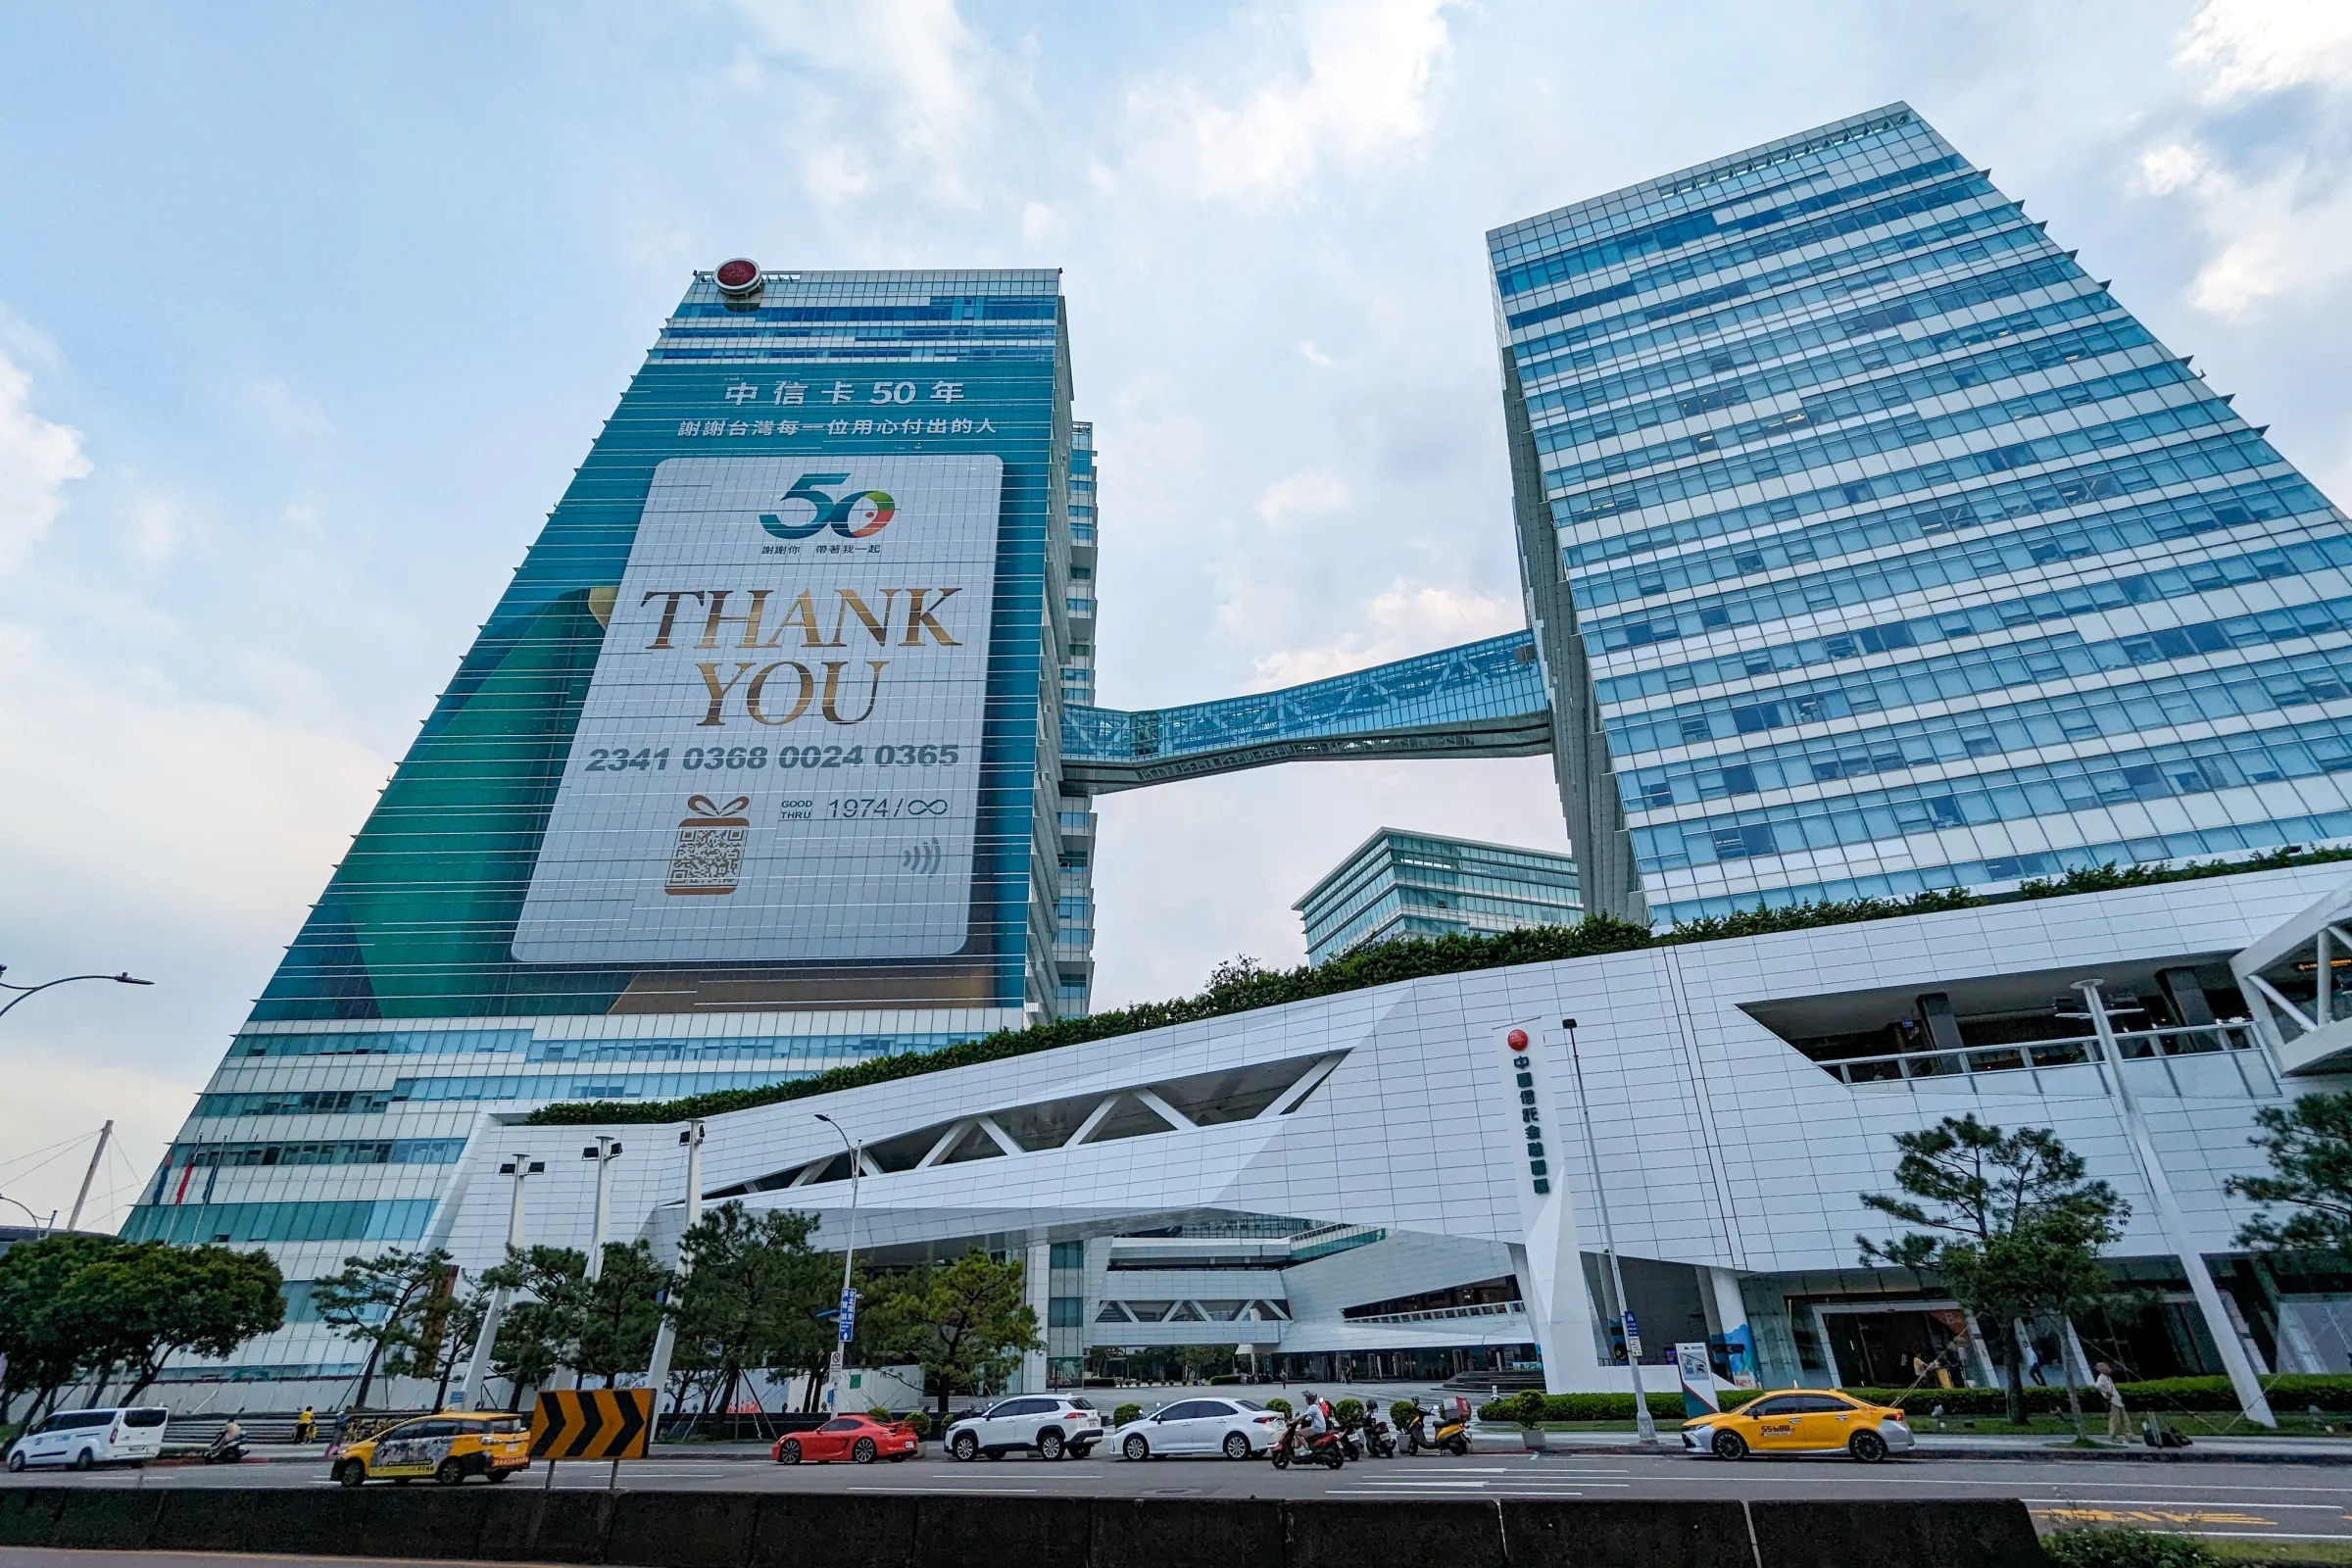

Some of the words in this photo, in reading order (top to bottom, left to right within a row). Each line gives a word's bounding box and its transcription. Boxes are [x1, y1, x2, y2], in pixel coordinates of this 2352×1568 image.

[677, 417, 998, 437] 謝謝台灣每一位用心付出的人
[759, 473, 896, 540] 50
[761, 545, 801, 555] 謝謝你
[815, 545, 881, 555] 帶著我一起
[640, 587, 963, 650] THANK
[695, 661, 890, 726] YOU
[585, 748, 670, 772] 2341
[682, 747, 767, 770] 0368
[778, 746, 863, 769] 0024
[874, 744, 959, 767] 0365
[781, 800, 812, 808] GOOD
